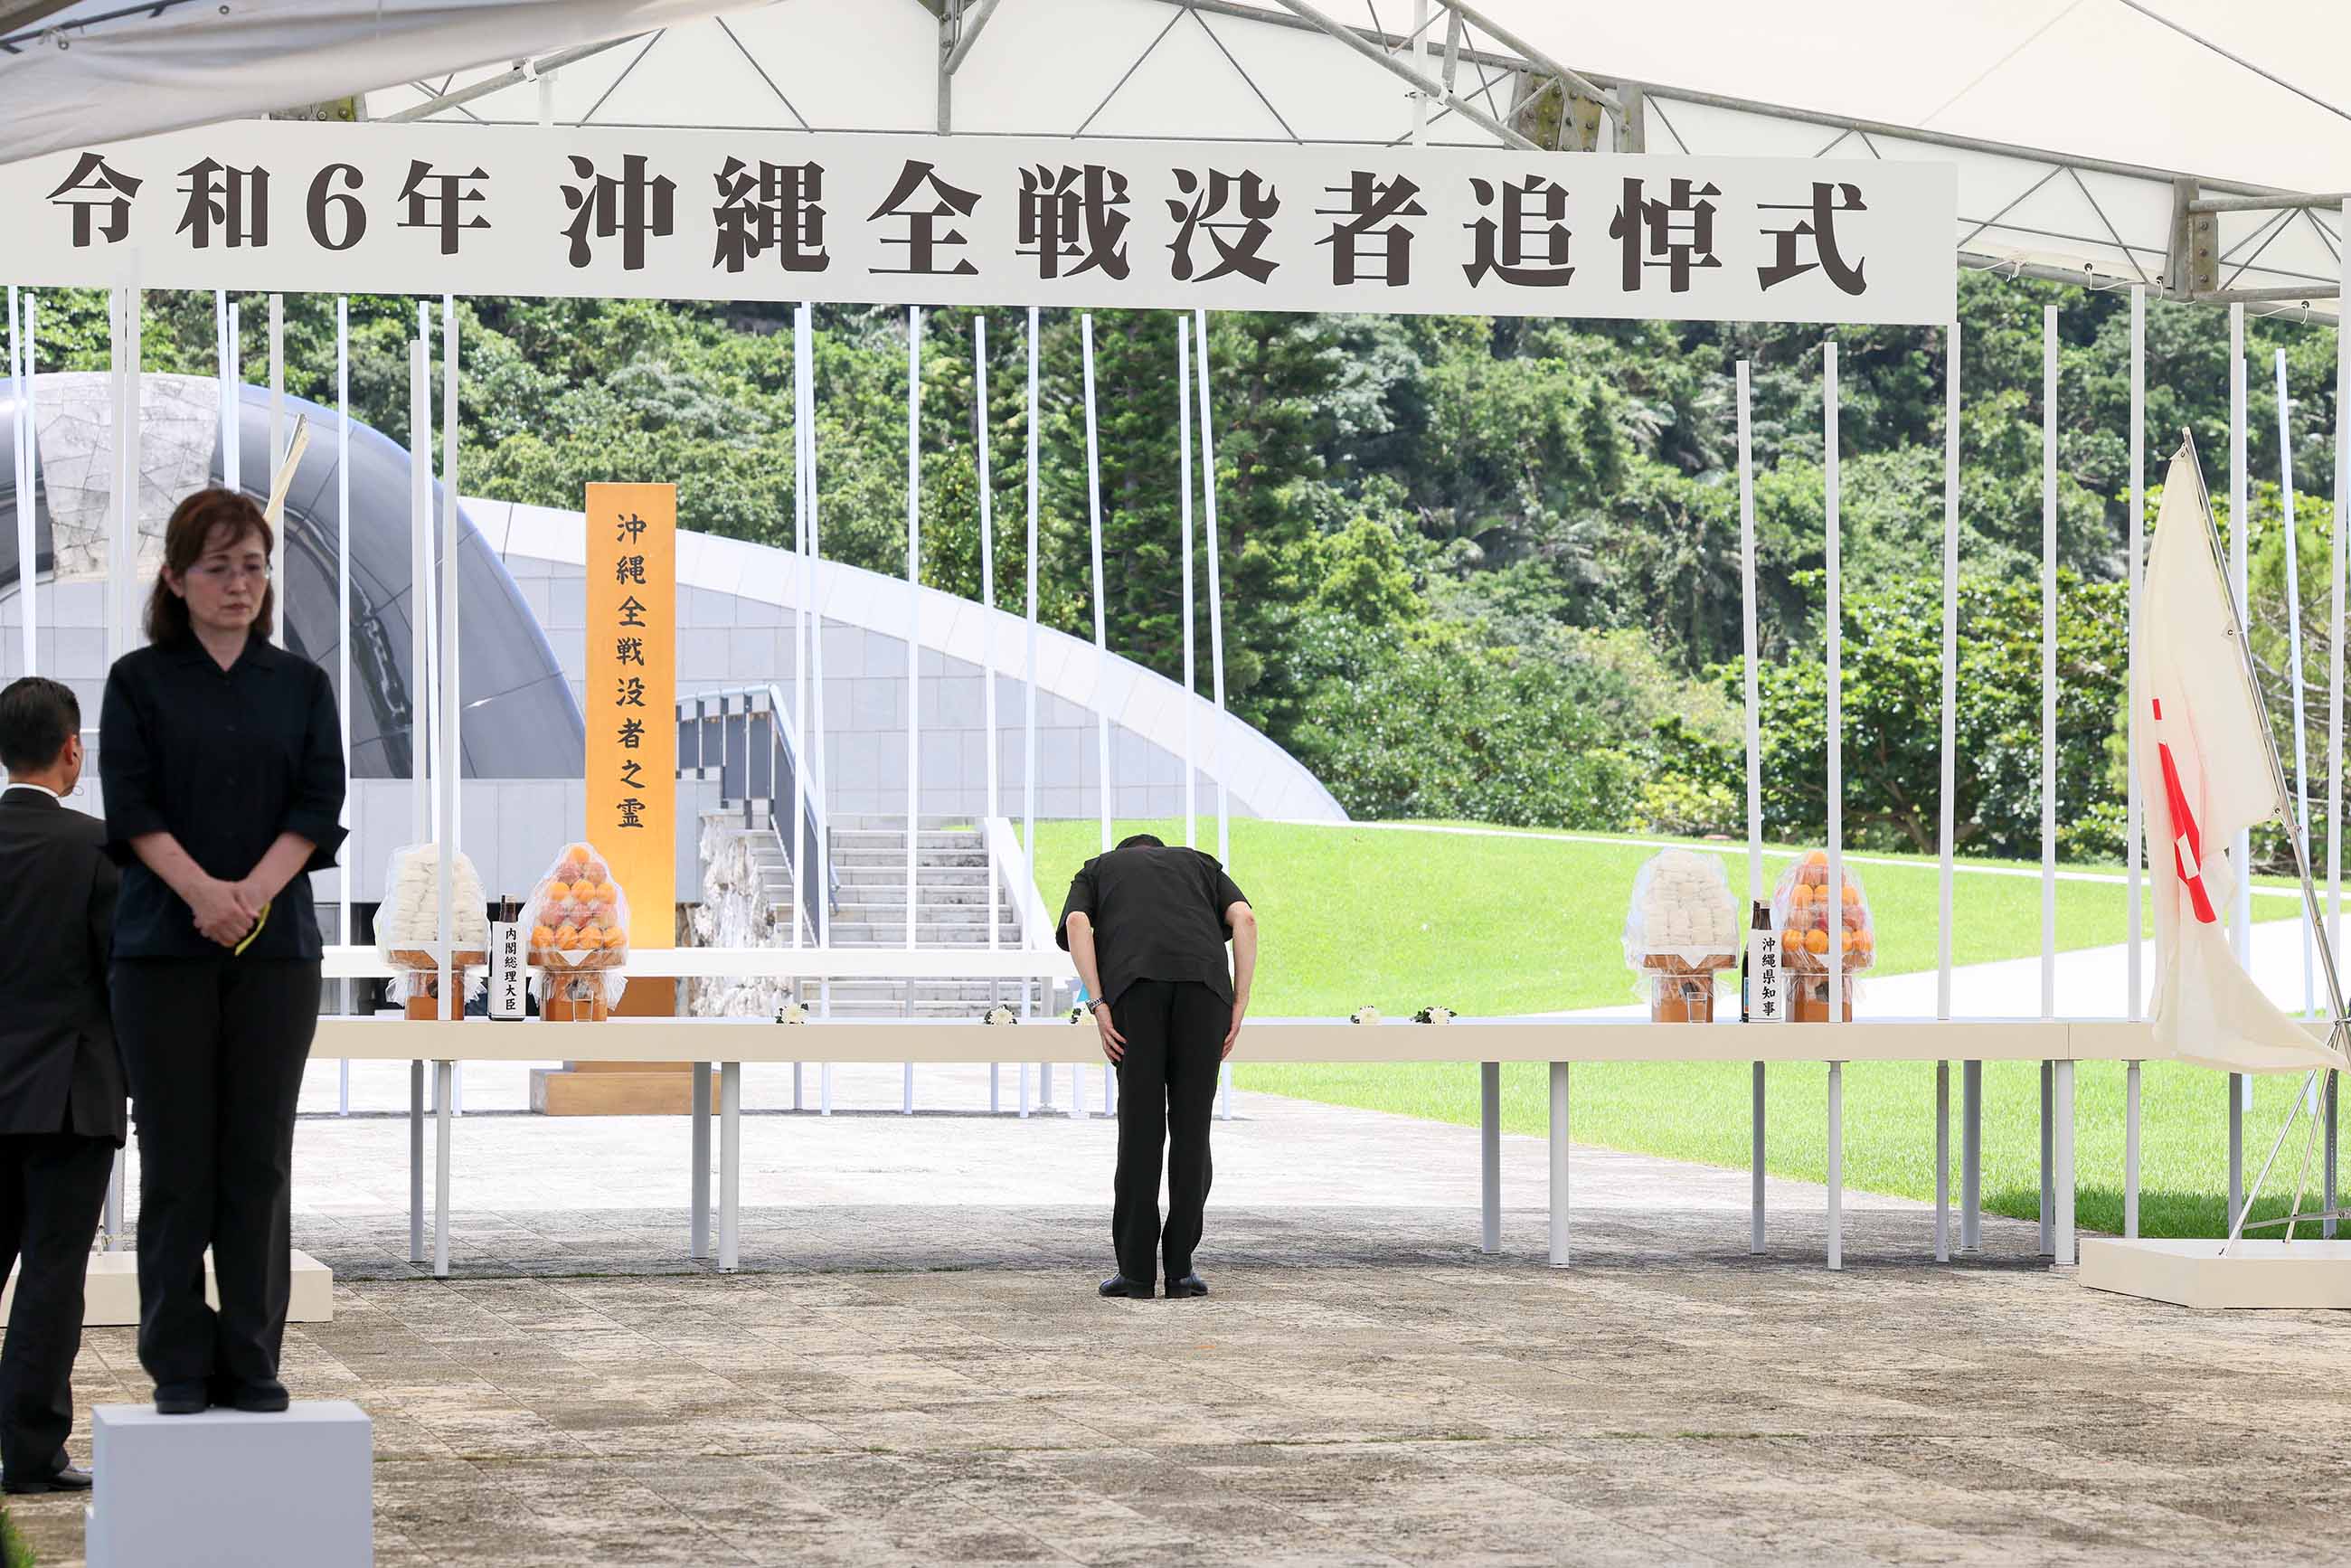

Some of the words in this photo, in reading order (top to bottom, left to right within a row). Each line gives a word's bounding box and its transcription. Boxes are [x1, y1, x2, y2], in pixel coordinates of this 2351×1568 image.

[46, 151, 492, 255] 令和6年
[559, 153, 1868, 297] 沖縄全戦没者追悼式
[615, 513, 647, 828] 沖縄全戦没者之霊
[504, 927, 518, 1011] 内閣総理大臣
[1761, 937, 1777, 1016] 沖縄県知事
